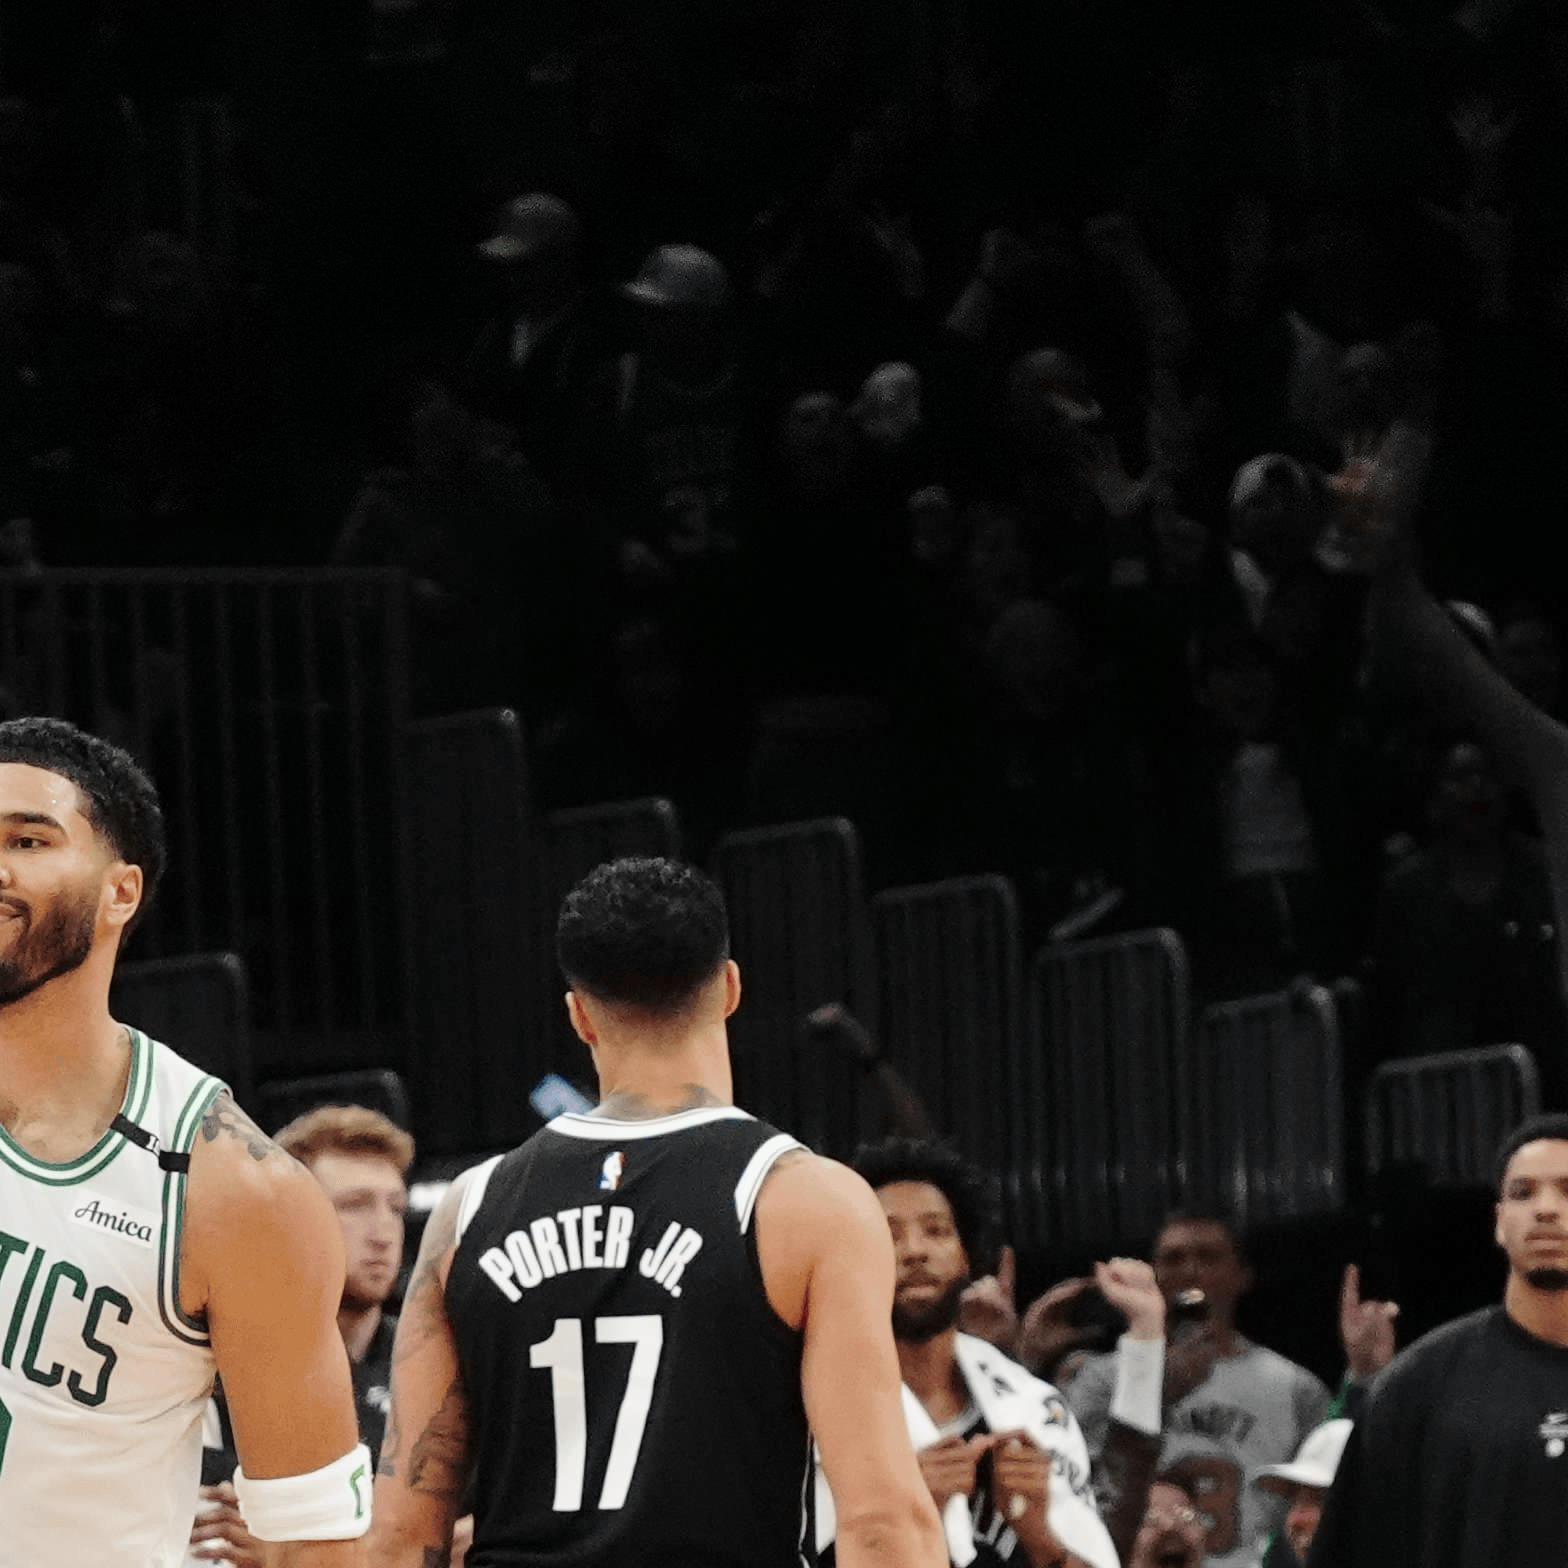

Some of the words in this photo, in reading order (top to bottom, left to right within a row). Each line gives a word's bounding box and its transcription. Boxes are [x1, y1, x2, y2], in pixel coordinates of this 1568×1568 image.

[74, 1200, 152, 1242] Amica
[478, 1204, 635, 1303] PORTER
[638, 1220, 704, 1299] JR.
[530, 1314, 664, 1512] 17
